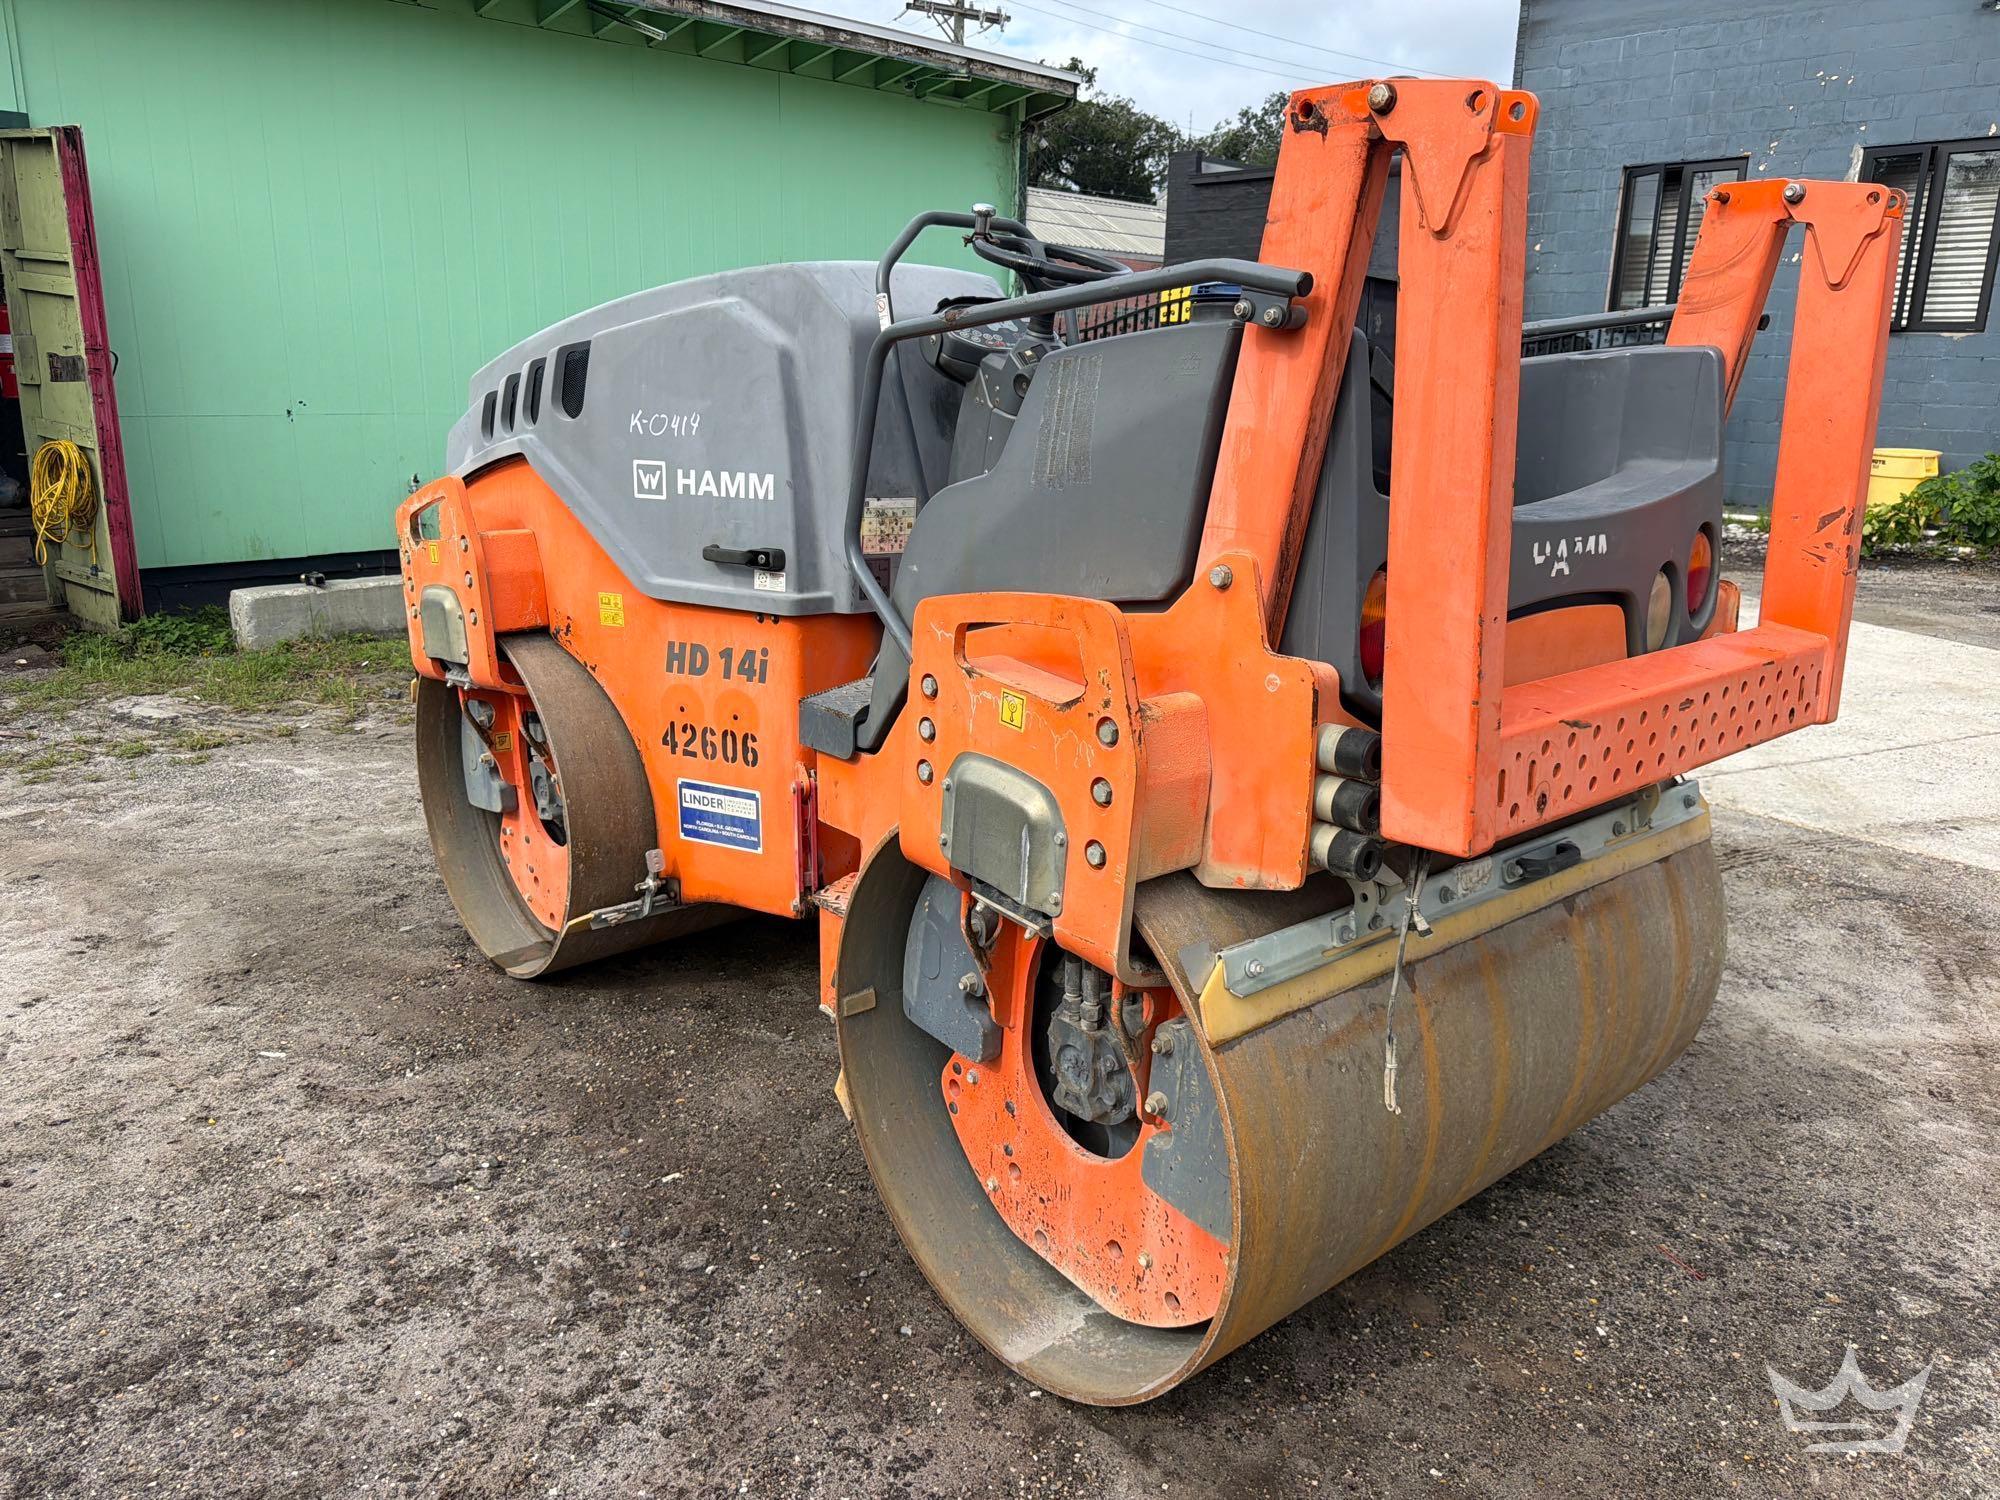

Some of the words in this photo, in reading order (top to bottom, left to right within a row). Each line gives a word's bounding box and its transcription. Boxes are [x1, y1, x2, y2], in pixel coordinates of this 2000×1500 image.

[677, 469, 775, 501] HAMM
[666, 640, 709, 677] HD
[718, 646, 769, 684] 14i
[662, 720, 759, 768] 42606
[683, 792, 724, 810] LINDER
[699, 825, 719, 834] CAROLINA
[722, 830, 736, 838] SOUTH
[737, 833, 758, 842] CAROLINA
